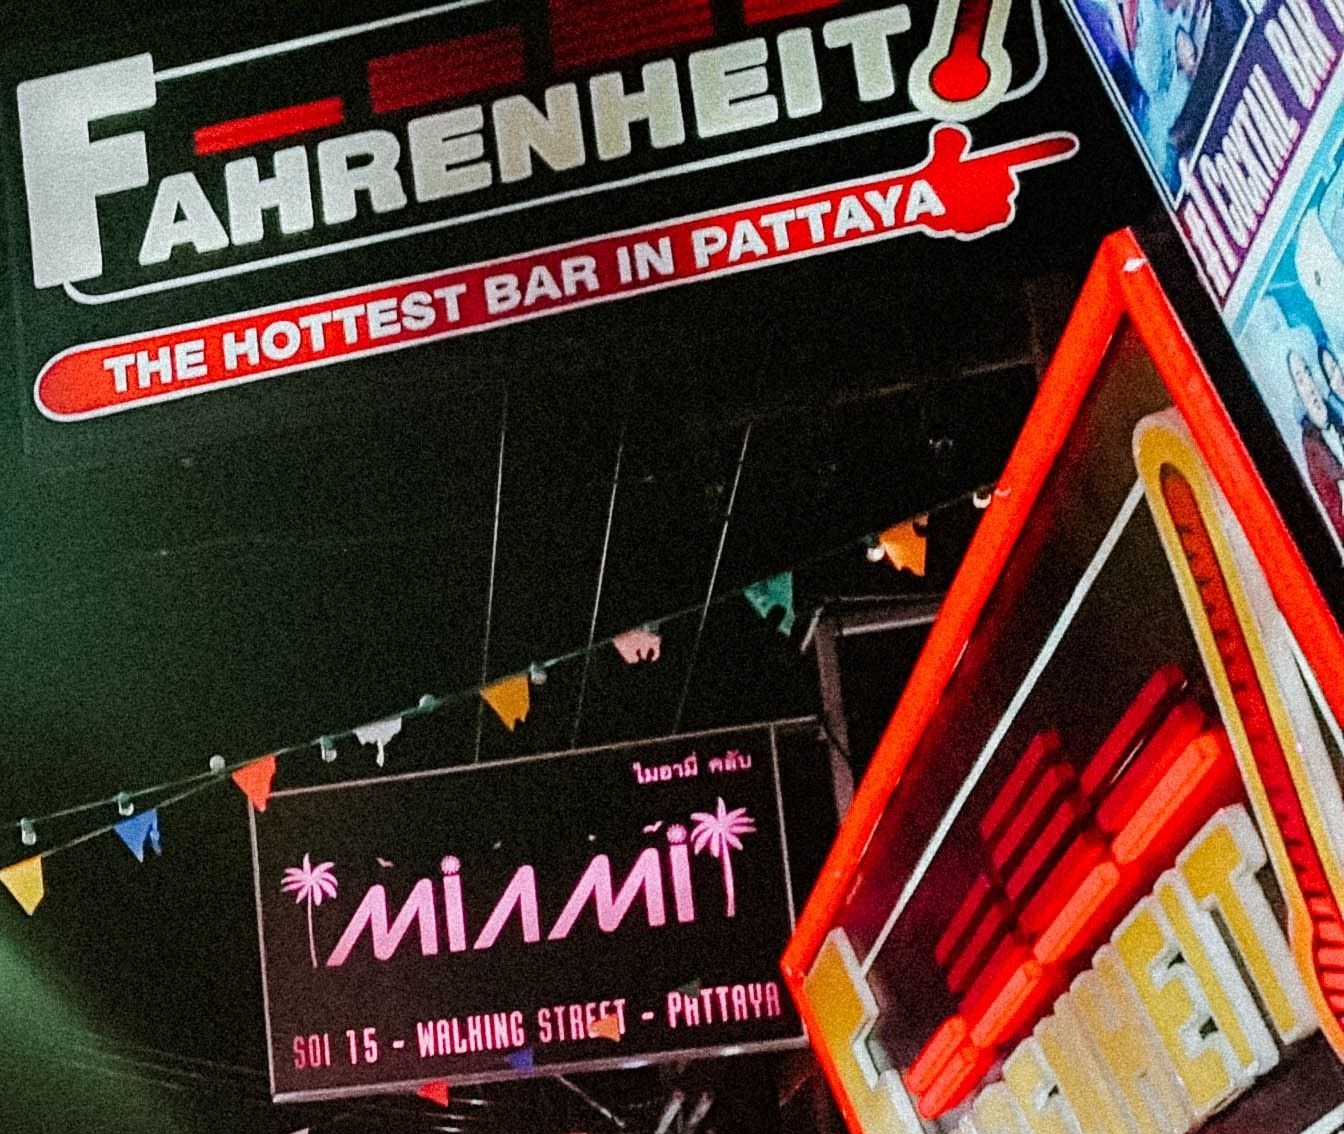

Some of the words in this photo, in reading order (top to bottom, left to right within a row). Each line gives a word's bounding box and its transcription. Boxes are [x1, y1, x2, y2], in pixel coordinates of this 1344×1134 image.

[16, 4, 918, 290] FAHRENHEIT
[103, 340, 209, 394] THE
[223, 284, 468, 370] HOTTEST
[484, 253, 600, 314] BAR
[615, 237, 678, 286] IN
[693, 179, 947, 270] PATTAYA
[293, 1034, 331, 1069] SOI
[346, 1027, 378, 1065] 15
[417, 1011, 526, 1058] WALKING
[538, 999, 627, 1044] STREET
[667, 982, 782, 1029] PATTAYA
